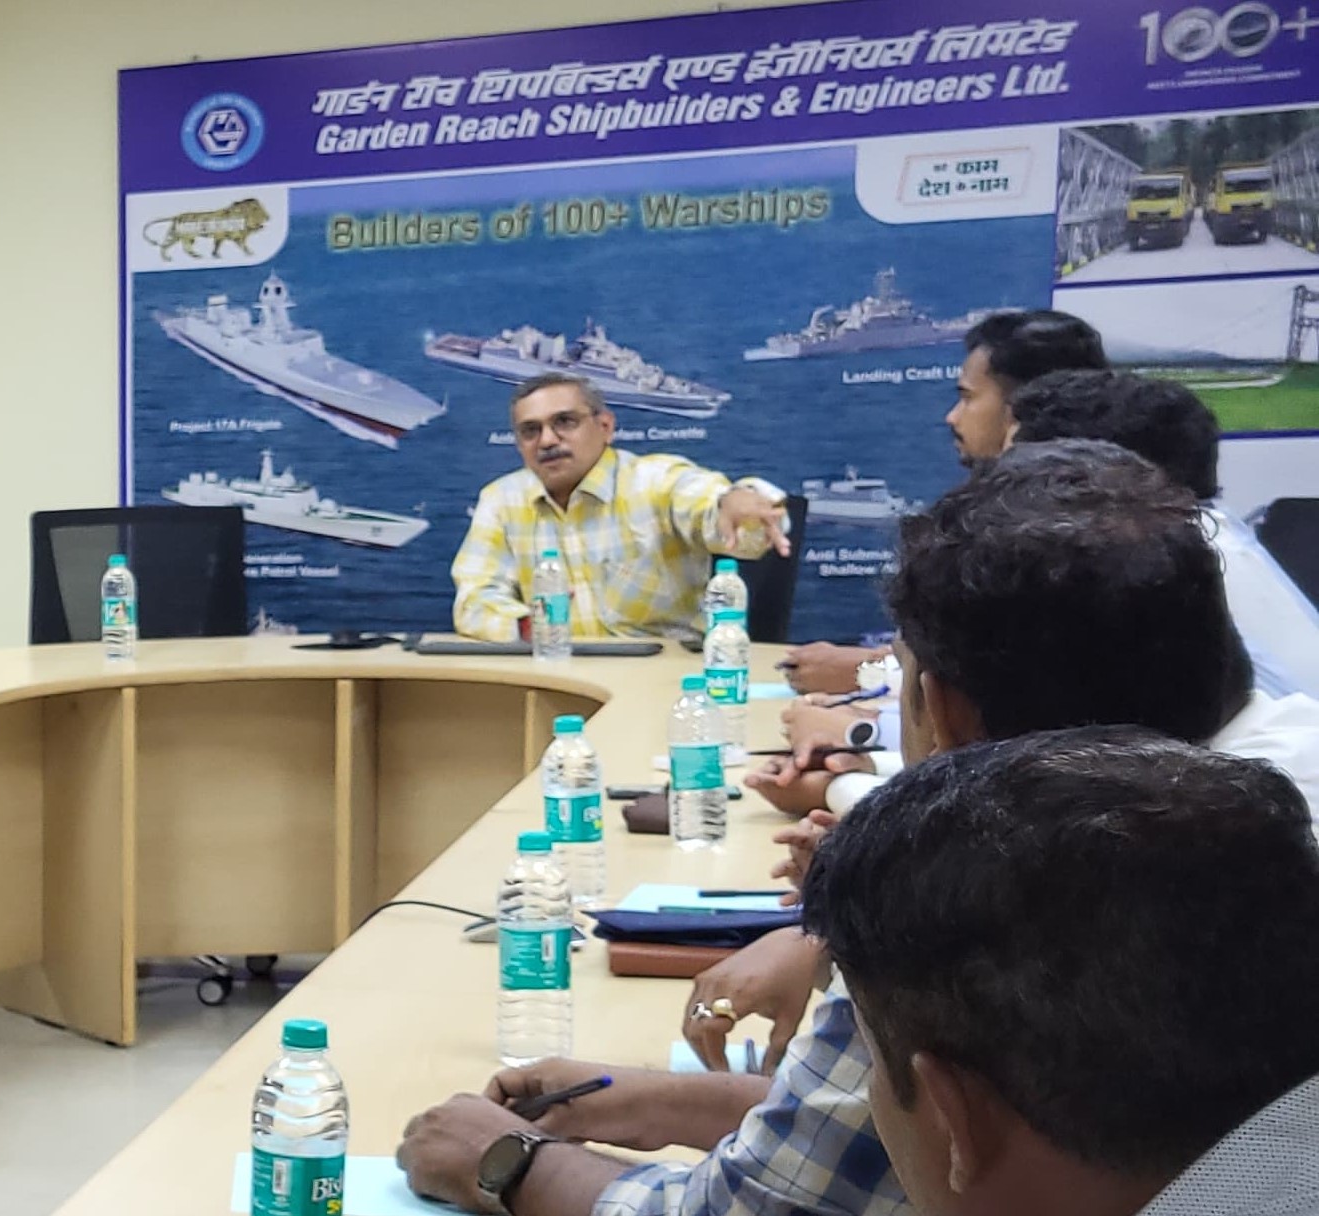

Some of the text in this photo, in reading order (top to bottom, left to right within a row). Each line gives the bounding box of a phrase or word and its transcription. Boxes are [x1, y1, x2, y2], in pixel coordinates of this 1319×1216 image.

[1140, 1, 1319, 65] 100+
[312, 80, 400, 116] गार्डन
[467, 55, 663, 104] शिपबिल्डर्स
[663, 52, 747, 90] एण्ड
[744, 29, 930, 83] इंजीनियर्स
[925, 18, 1079, 64] लिमिटेड
[316, 61, 1069, 154] Garden Reach Shipbuilders & Engineers Ltd.
[331, 187, 830, 250] Builders of 100+ Warships
[843, 370, 902, 384] Landing
[905, 366, 943, 380] Craft
